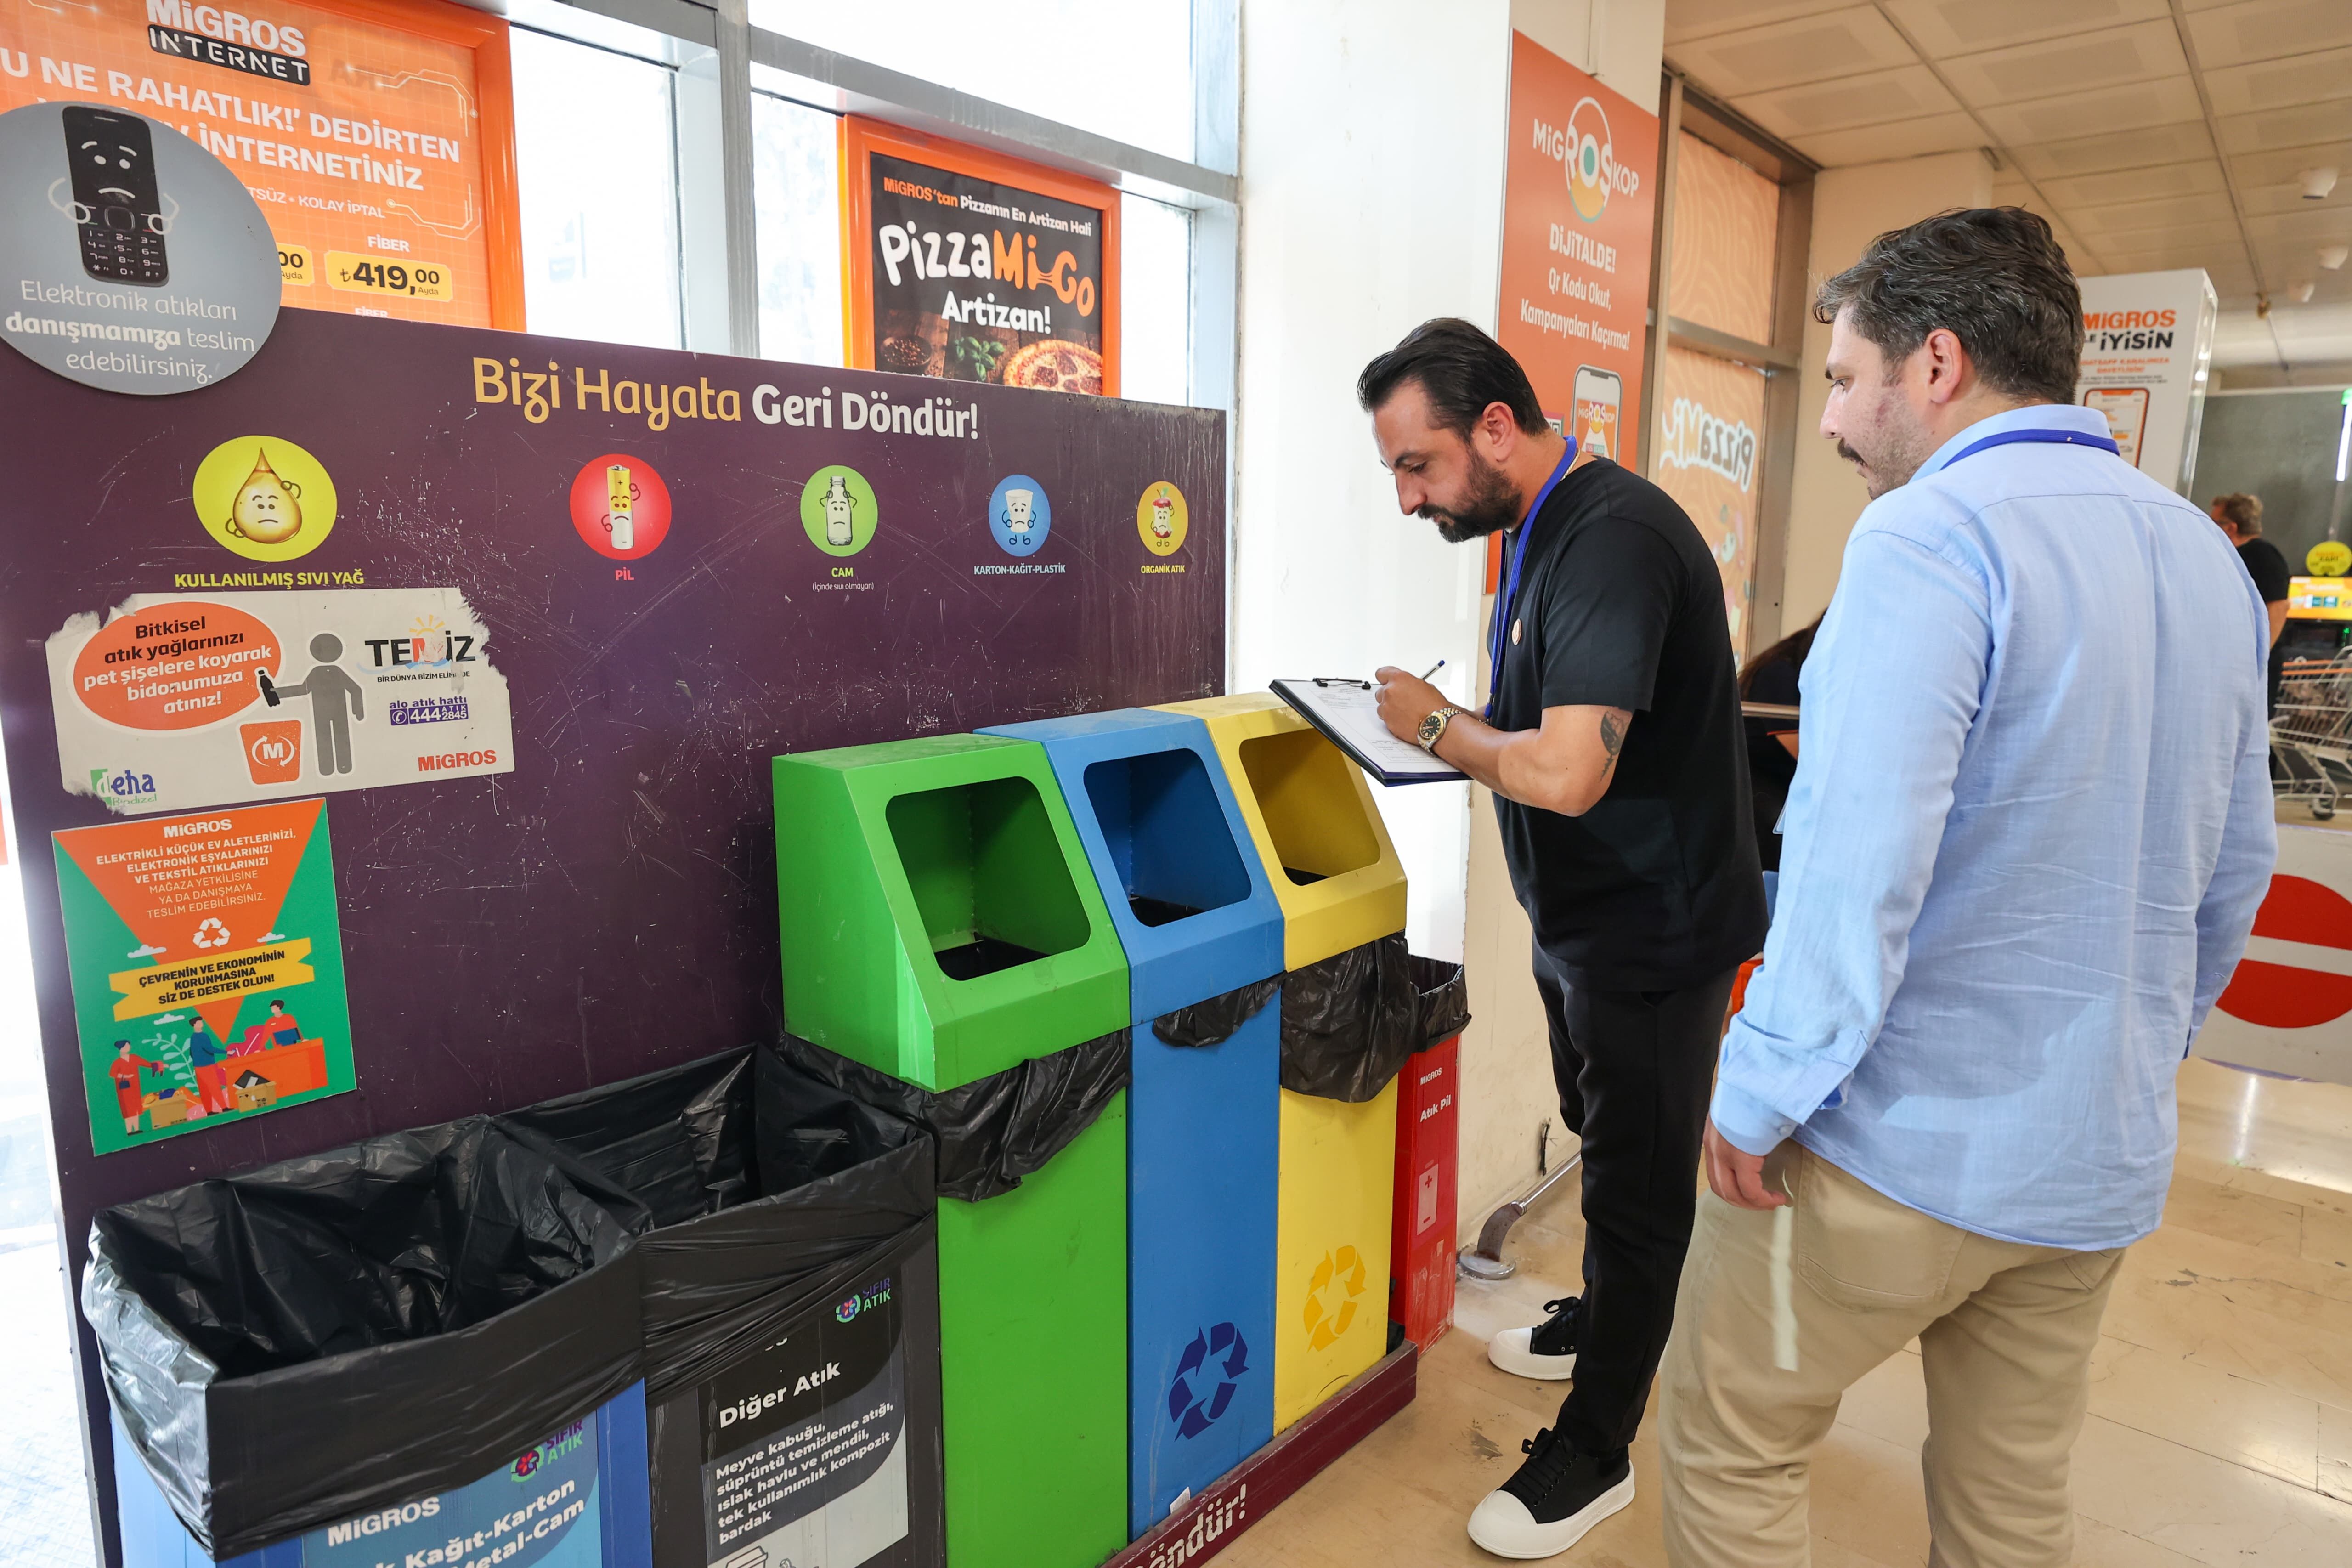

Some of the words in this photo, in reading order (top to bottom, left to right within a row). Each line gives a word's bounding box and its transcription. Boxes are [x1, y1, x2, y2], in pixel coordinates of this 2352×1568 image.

[149, 28, 308, 82] INTERNET
[40, 56, 98, 92] NE
[309, 113, 459, 163] DEDİRTEN
[299, 195, 344, 212] KOLAY
[347, 200, 385, 219] İPTAL
[960, 195, 1010, 219] Pizzanın
[1012, 207, 1026, 223] En
[1028, 212, 1069, 232] Artizan
[1070, 220, 1092, 237] Hali
[368, 234, 410, 252] FİBER
[21, 280, 148, 312] Elektronik
[155, 295, 237, 321] atıkları
[418, 286, 439, 296] Ayda
[1548, 267, 1561, 295] Qr
[1563, 272, 1587, 302] Kodu
[1589, 283, 1612, 311] Okut,
[941, 290, 1052, 334] Artizan!
[1520, 298, 1590, 339] Kampanyaları
[1591, 320, 1631, 351] Kaçırma!
[6, 311, 181, 351] danışmamıza
[187, 328, 255, 352] teslim
[66, 350, 213, 384] edebilirsiniz.
[472, 357, 561, 424] Bizi
[575, 367, 741, 431] Hayata
[752, 384, 832, 428] Geri
[842, 391, 979, 440] Döndür!
[174, 572, 294, 590] KULLANILMIŞ
[297, 572, 329, 585] SIVI
[332, 568, 364, 585] YAĞ
[615, 566, 634, 581] PİL
[831, 567, 854, 577] CAM
[973, 562, 1066, 575] KARTON-KAĞIT-PLASTİK
[1141, 563, 1170, 574] ORGANİK
[1170, 564, 1185, 574] ATIK
[845, 582, 874, 592] olmayan)
[136, 616, 206, 639] Bitkisel
[104, 644, 142, 663] atık
[146, 632, 244, 661] yağlarınızı
[84, 670, 117, 691] pet
[121, 659, 195, 685] şişelere
[198, 645, 272, 669] koyarak
[127, 671, 243, 702] bidonumuza
[164, 691, 222, 714] atınız!
[389, 700, 408, 709] alo
[412, 698, 435, 707] atık
[439, 696, 467, 705] hattı
[410, 708, 441, 723] 444
[442, 711, 467, 720] 2845
[262, 742, 283, 759] M
[96, 845, 164, 865] ELEKTRİKLİ
[166, 842, 205, 856] KÜÇÜK
[208, 840, 221, 850] EV
[223, 828, 296, 848] ALETLERİNİZİ,
[127, 854, 198, 873] ELEKTRONİK
[201, 844, 273, 863] EŞYALARINIZI
[134, 874, 150, 884] VE
[152, 866, 198, 882] TEKSTİL
[199, 856, 269, 875] ATIKLARINIZI
[149, 880, 194, 894] MAĞAZA
[159, 896, 173, 905] YA
[175, 893, 190, 903] DA
[193, 883, 253, 900] DANIŞMAYA
[147, 904, 186, 918] TESLİM
[189, 892, 266, 912] EDEBİLİRSİNİZ.
[139, 966, 198, 988] ÇEVRENİN
[200, 963, 215, 974] VE
[217, 950, 285, 971] EKONOMİNİN
[175, 967, 256, 990] KORUNMASINA
[158, 992, 177, 1004] SİZ
[180, 990, 195, 1000] DE
[198, 980, 241, 997] DESTEK
[243, 974, 275, 987] OLUN!
[1420, 1104, 1438, 1122] Atık
[1440, 1094, 1452, 1110] Pil
[863, 1288, 891, 1312] ATIK
[719, 1387, 787, 1429] Diğer
[793, 1361, 841, 1397] Atık
[548, 1431, 583, 1465] ATIK
[716, 1455, 785, 1496] süprüntü
[788, 1420, 859, 1462] temizleme
[862, 1402, 894, 1424] atığı,
[716, 1450, 765, 1480] Meyve
[768, 1423, 826, 1456] kabuğu,
[718, 1487, 754, 1513] ıslak
[757, 1466, 797, 1494] havlu
[800, 1457, 818, 1472] ve
[821, 1429, 870, 1462] mendil,
[718, 1507, 745, 1528] tek
[747, 1467, 827, 1515] kullanımlık
[830, 1431, 891, 1472] kompozit
[405, 1479, 575, 1568] Kağıt-Karton
[719, 1510, 772, 1545] bardak
[1135, 1483, 1246, 1568] öndür!
